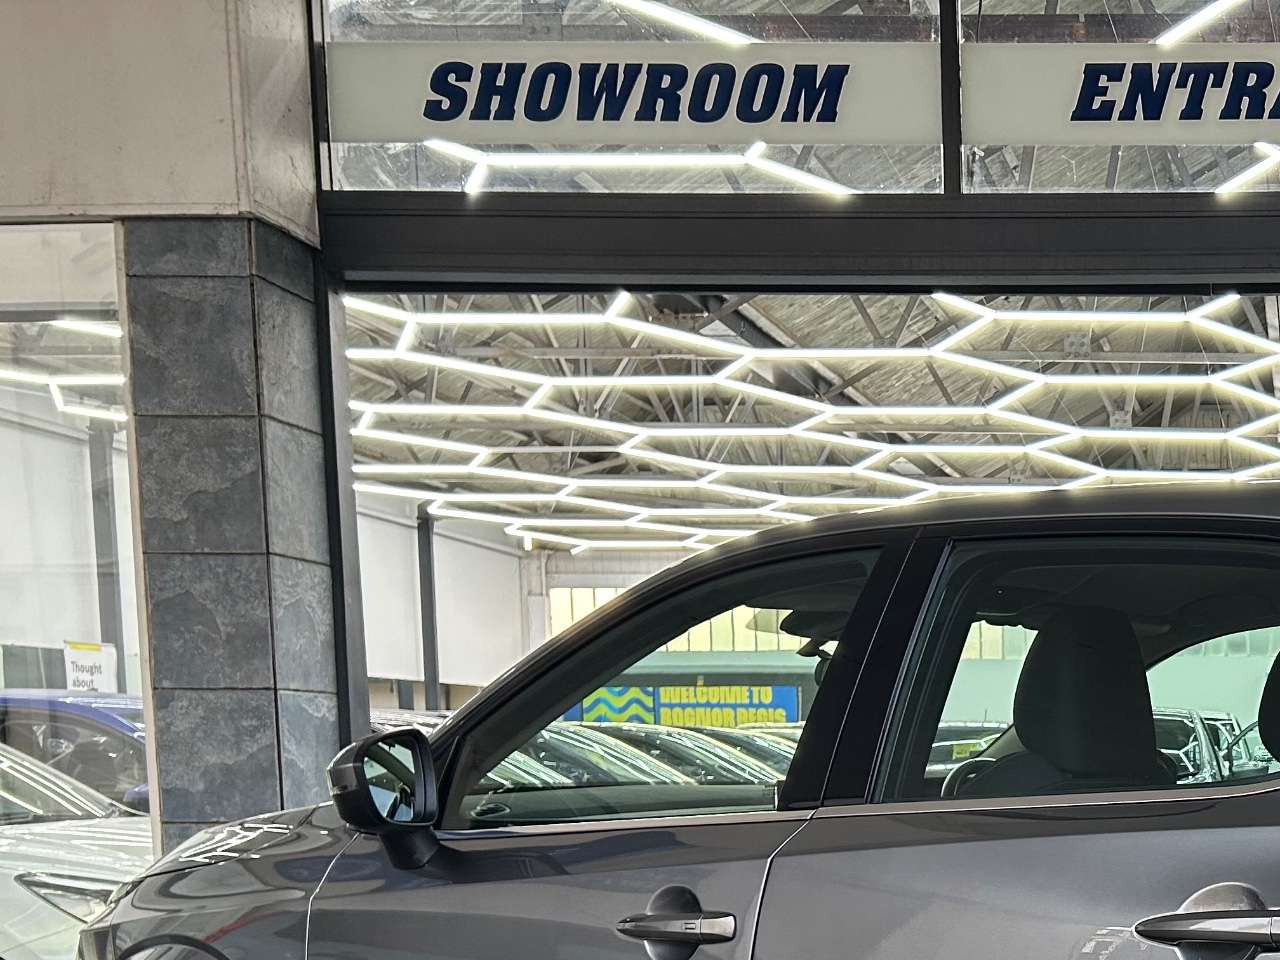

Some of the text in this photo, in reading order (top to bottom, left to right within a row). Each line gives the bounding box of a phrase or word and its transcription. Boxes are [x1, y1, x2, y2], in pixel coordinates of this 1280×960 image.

[423, 62, 849, 123] SHOWROOM
[71, 661, 103, 677] Thought
[659, 685, 773, 704] WELCOME TO
